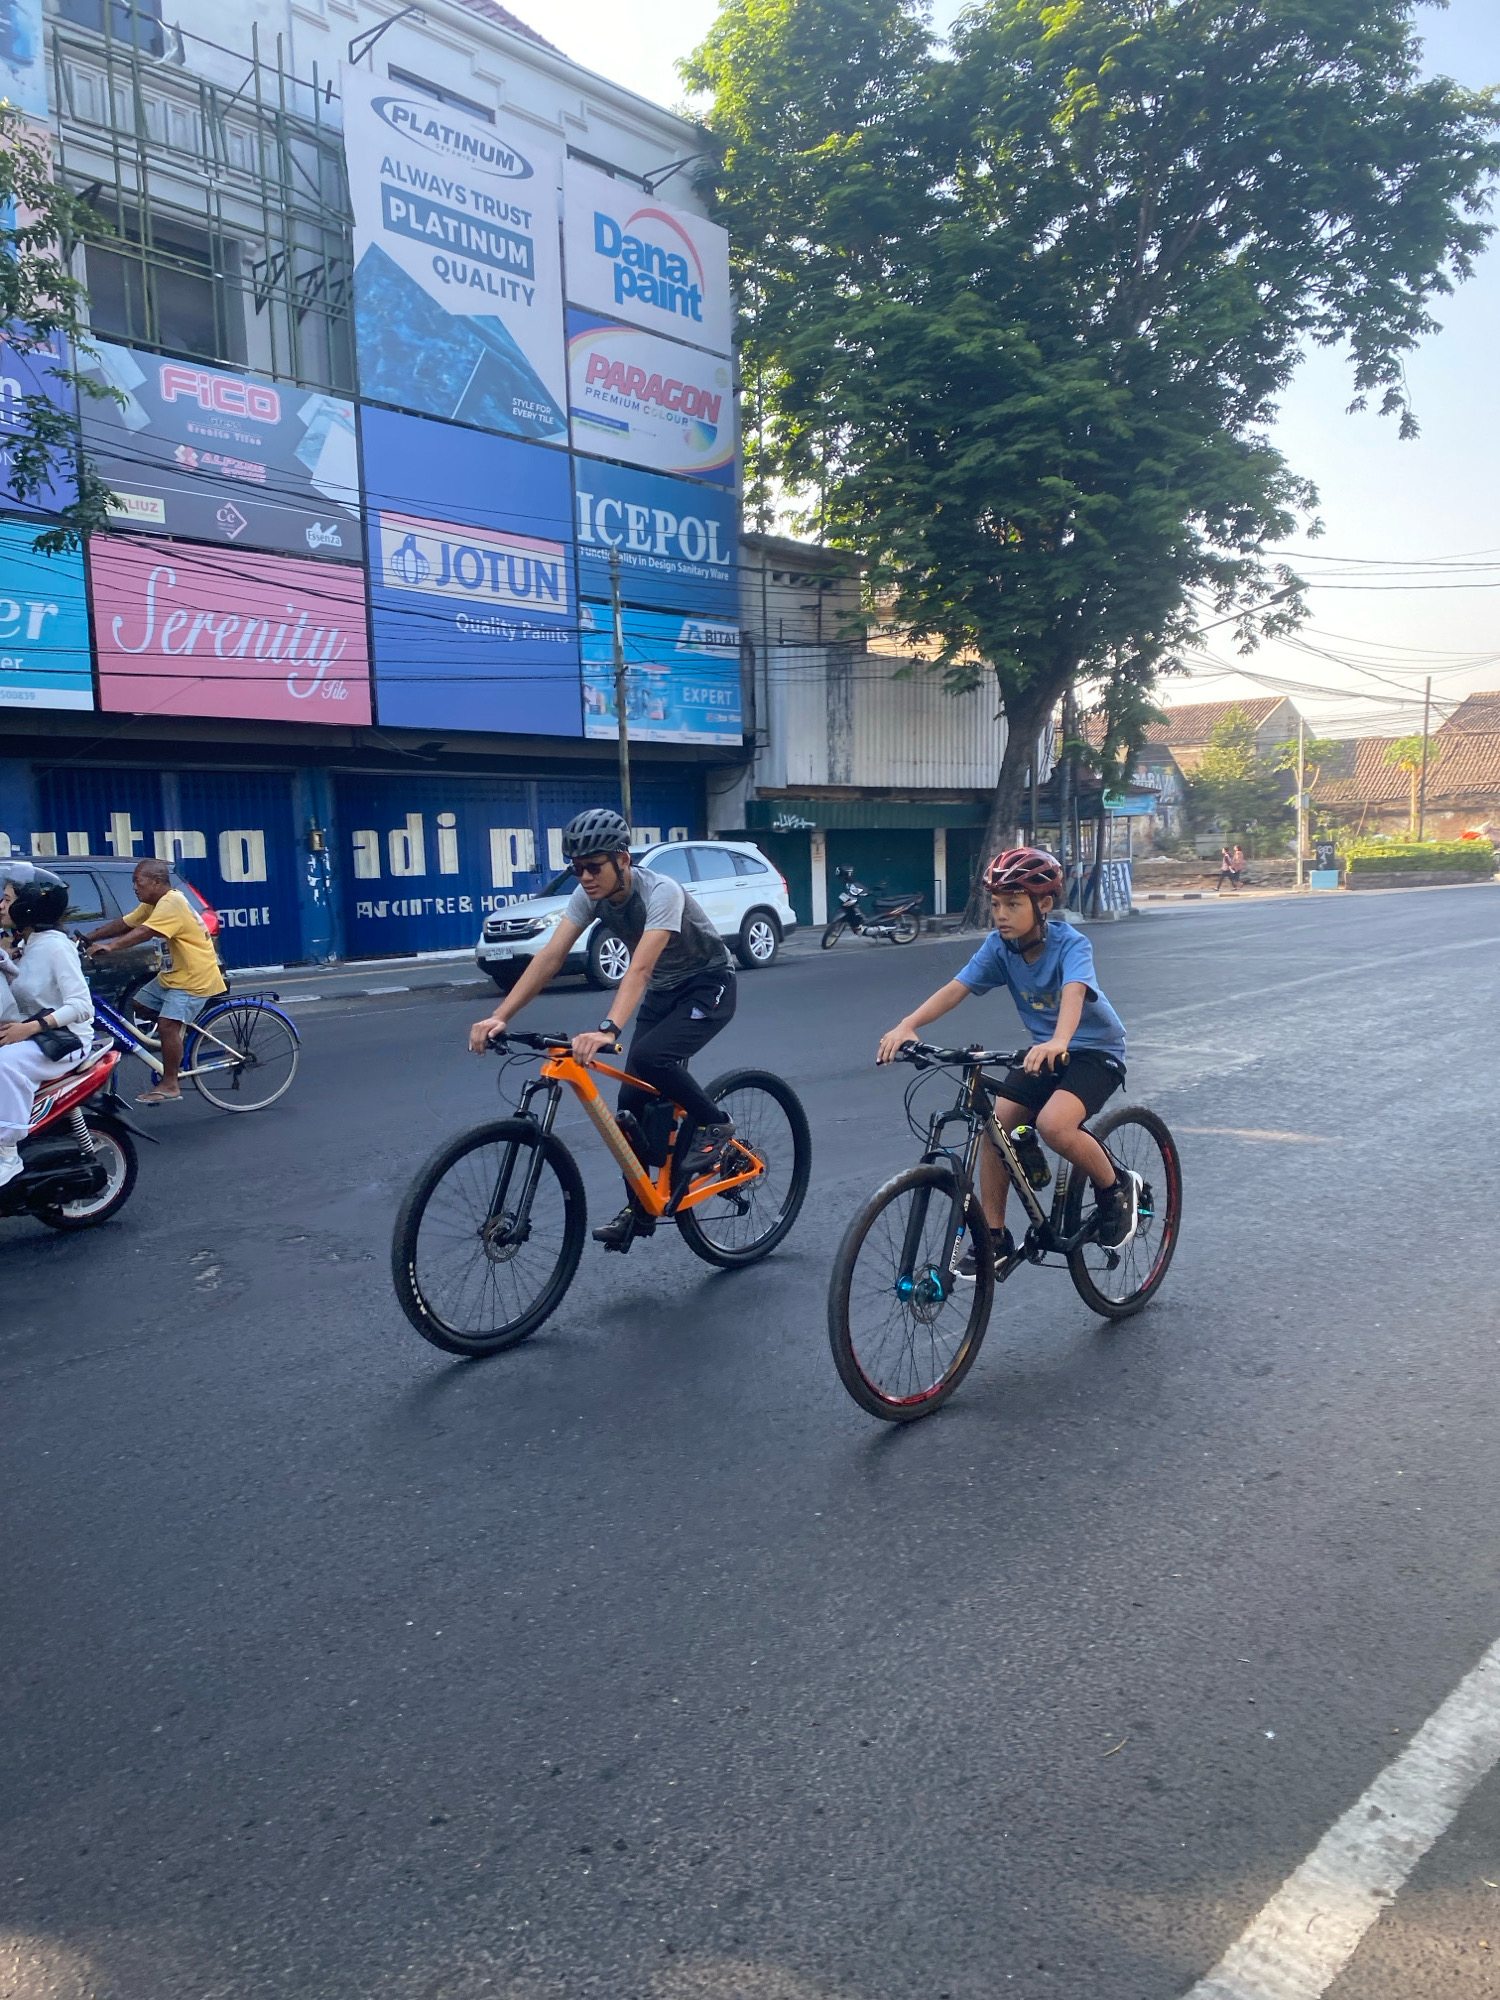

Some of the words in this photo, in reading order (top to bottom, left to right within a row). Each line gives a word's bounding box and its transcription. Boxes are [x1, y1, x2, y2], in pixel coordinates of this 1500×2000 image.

[391, 105, 515, 171] PLATINUM
[380, 156, 467, 205] ALWAYS
[470, 190, 532, 229] TRUST
[389, 196, 528, 269] PLATINUM
[594, 211, 688, 288] Dana
[432, 255, 535, 307] QUALITY
[613, 262, 703, 322] paint
[512, 397, 534, 411] STYLE
[536, 403, 552, 415] FOR
[585, 353, 722, 424] PARAGON
[585, 387, 640, 411] PREMIUM
[643, 405, 689, 427] COLOUR
[512, 407, 538, 420] EVERY
[538, 413, 554, 425] TILE
[308, 530, 341, 545] Essenza
[575, 491, 731, 565] ICEPOL
[435, 543, 559, 601] JOTUN
[580, 546, 637, 567] Functiality
[639, 554, 647, 566] in
[649, 557, 676, 573] Design
[678, 562, 710, 579] Sanitary
[710, 568, 729, 581] Ware
[112, 566, 347, 698] Serenity
[455, 612, 517, 641] Quality
[522, 621, 569, 643] Paints
[321, 680, 348, 700] Tile
[683, 687, 733, 706] EXPERT
[351, 812, 460, 879] adi
[215, 907, 270, 928] STORE
[458, 895, 474, 913] &
[96, 1015, 134, 1047] PHOENIX
